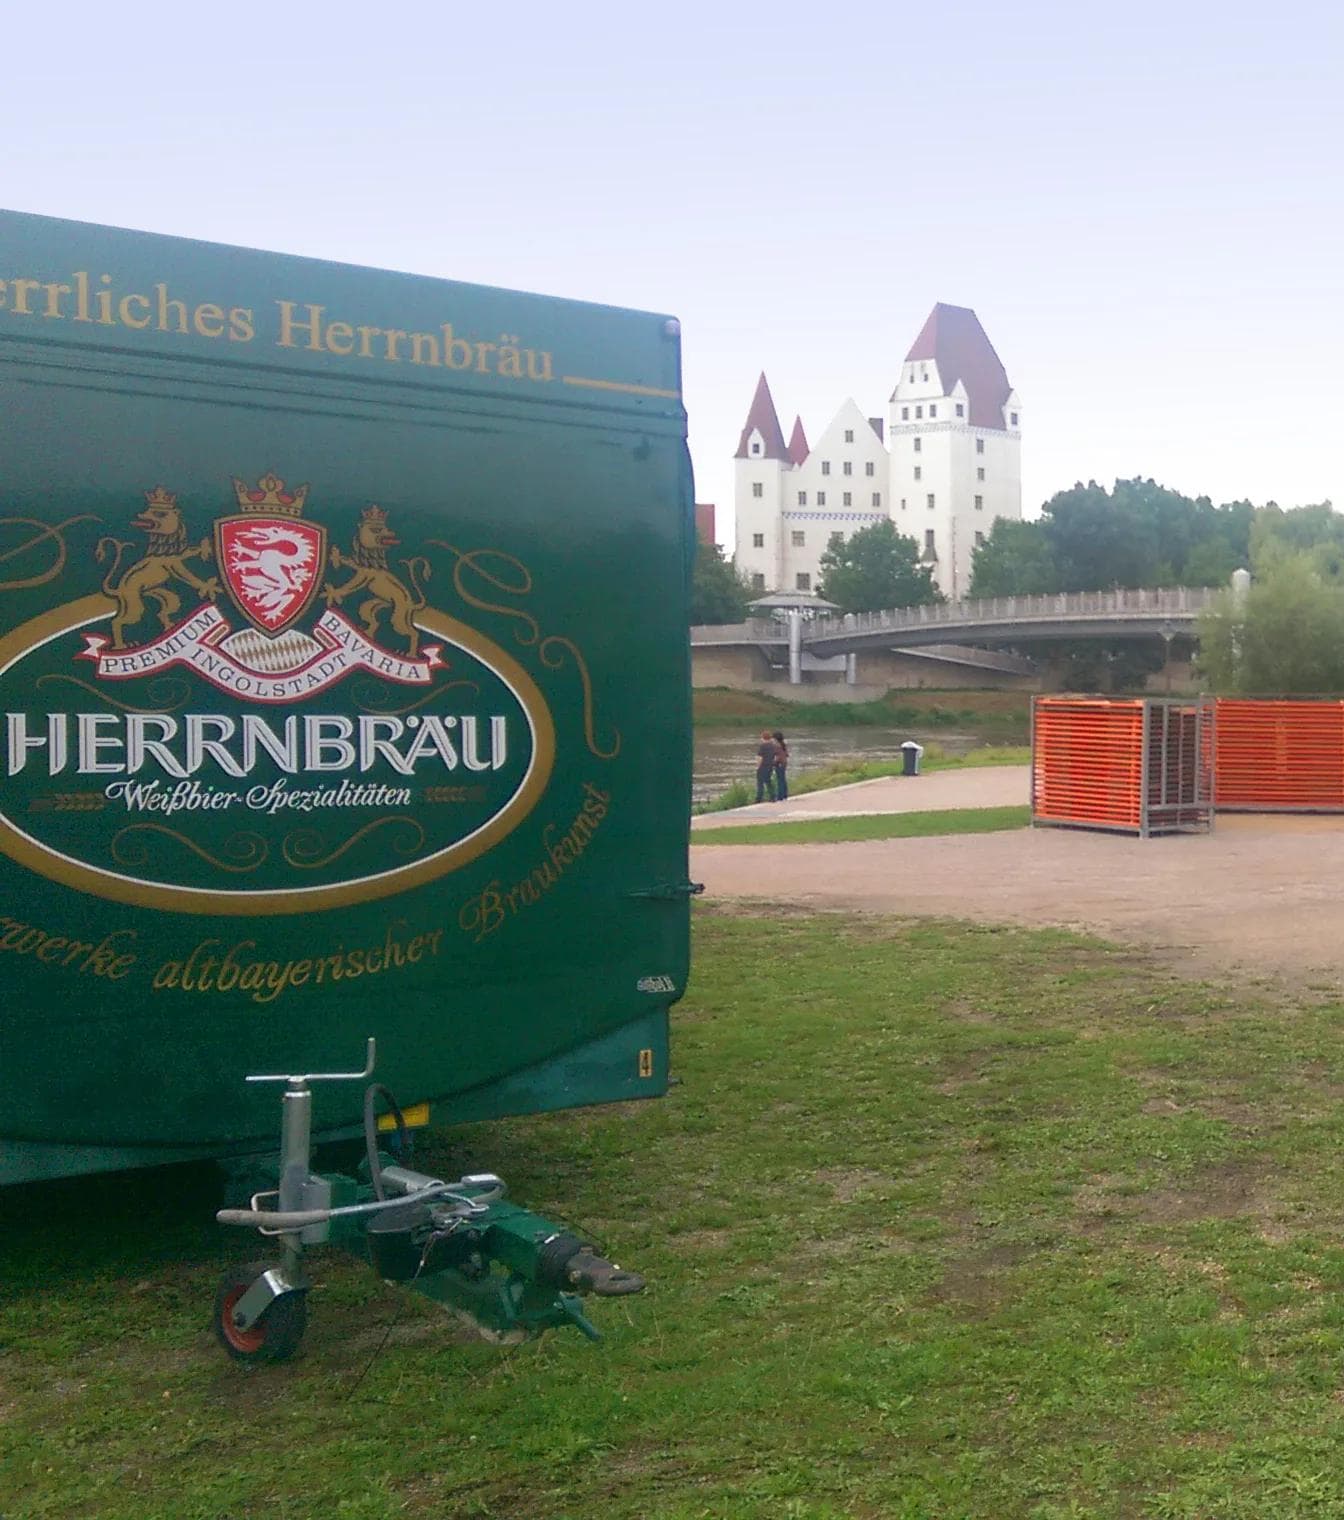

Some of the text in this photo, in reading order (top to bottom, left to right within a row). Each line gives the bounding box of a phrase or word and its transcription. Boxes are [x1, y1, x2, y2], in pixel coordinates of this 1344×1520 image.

[0, 271, 554, 380] rrliches Herrnbräu
[103, 609, 218, 674] PREMIUM
[189, 648, 346, 697] INGOLSTADT
[324, 615, 421, 679] BAVARIA
[5, 712, 507, 778] HERRNBRÄU
[152, 918, 444, 1002] altbayerischer
[458, 782, 610, 943] Braukunst
